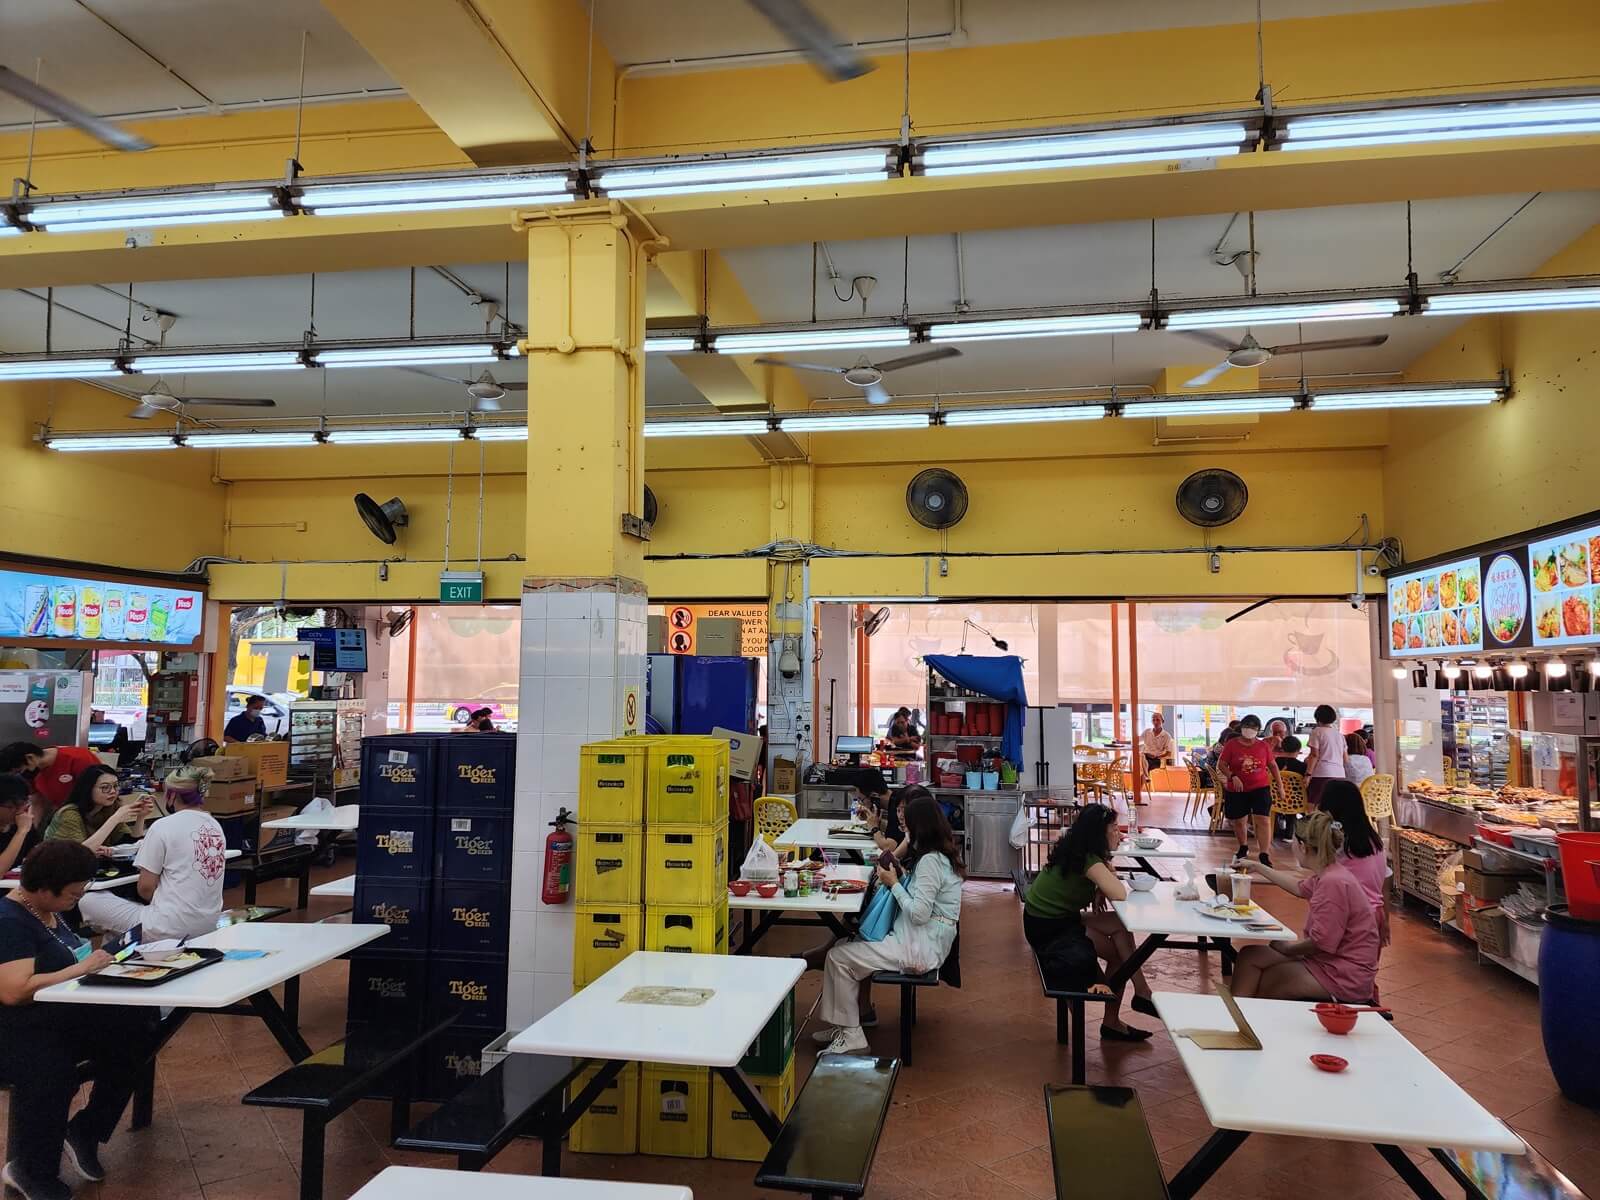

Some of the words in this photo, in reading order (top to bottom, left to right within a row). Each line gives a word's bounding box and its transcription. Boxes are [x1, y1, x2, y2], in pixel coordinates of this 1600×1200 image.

[449, 586, 473, 599] EXIT
[747, 637, 763, 645] YOU
[379, 764, 416, 783] Tiger
[457, 764, 496, 784] Tiger
[455, 836, 493, 855] Tiger
[452, 907, 491, 927] Tiger
[448, 980, 488, 1001] Tiger
